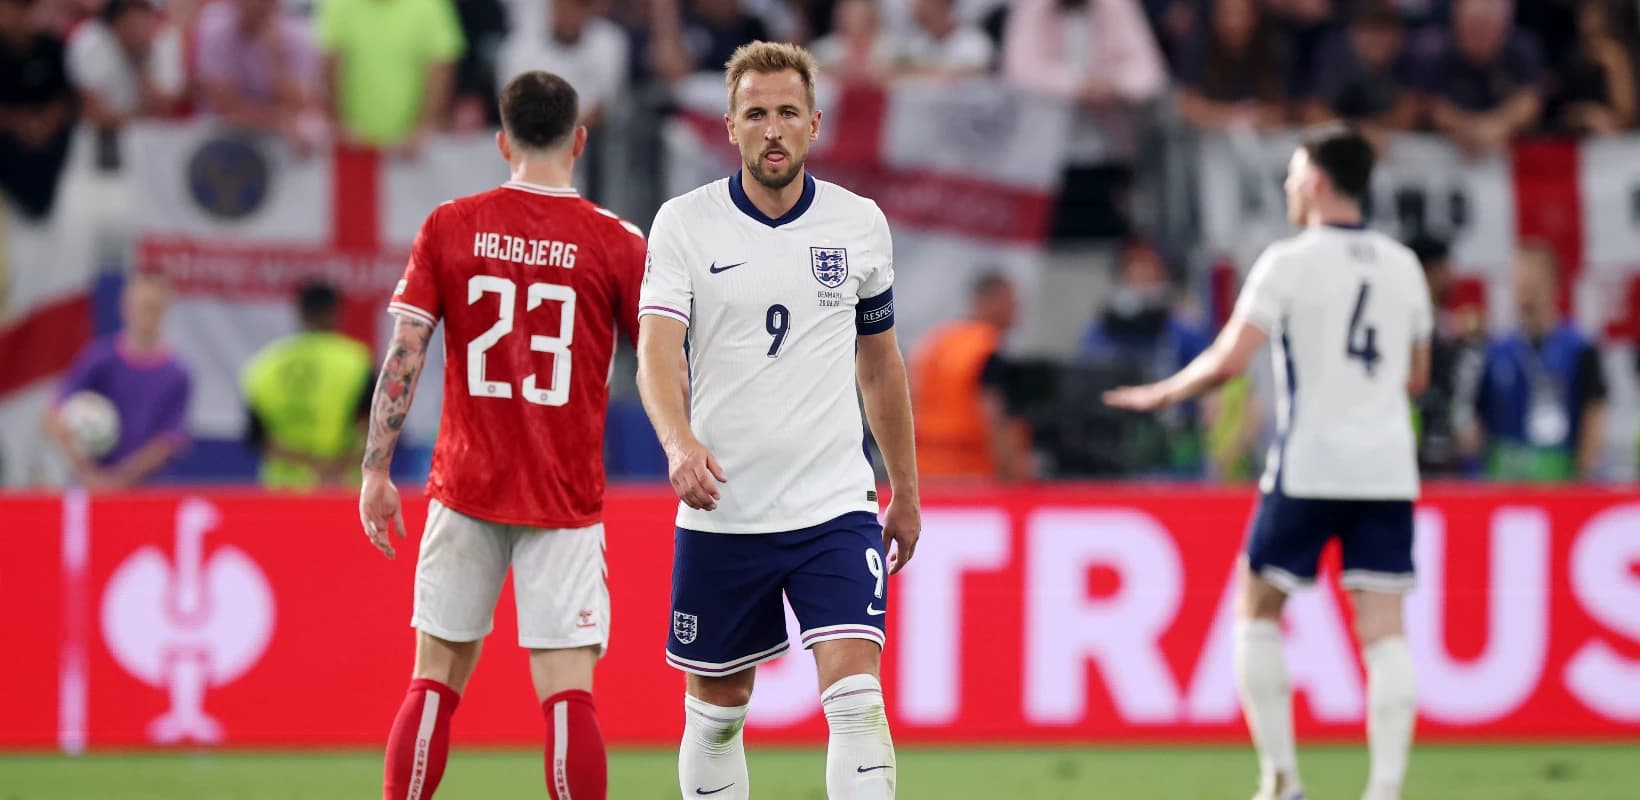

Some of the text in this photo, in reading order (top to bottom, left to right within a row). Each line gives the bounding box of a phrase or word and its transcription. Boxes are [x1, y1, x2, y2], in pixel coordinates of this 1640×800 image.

[473, 232, 578, 269] HØJBJERG
[765, 303, 791, 358] 9
[863, 302, 894, 321] RESPECT
[1346, 280, 1382, 377] 4
[467, 275, 577, 407] 23
[865, 547, 884, 599] 9
[744, 502, 1640, 727] TRAUS
